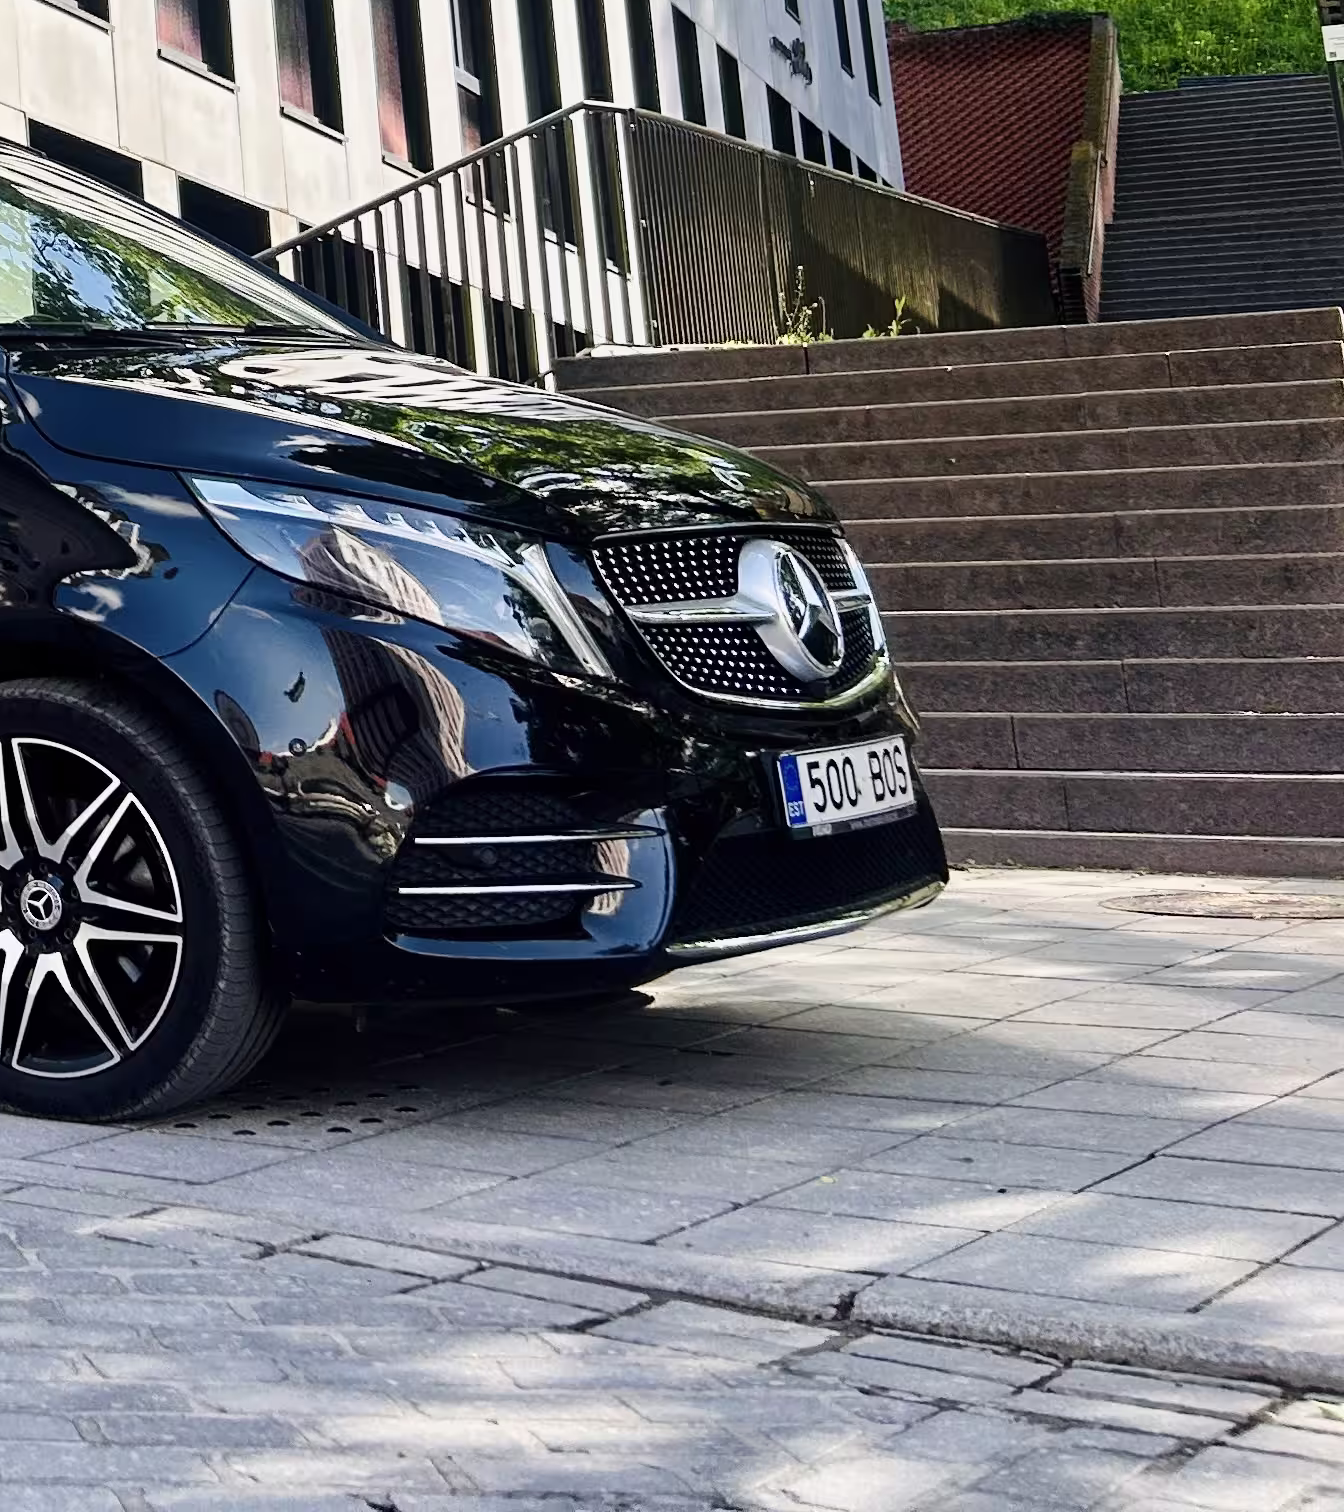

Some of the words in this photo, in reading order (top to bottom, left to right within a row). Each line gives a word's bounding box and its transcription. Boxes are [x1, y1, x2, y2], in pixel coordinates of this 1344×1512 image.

[806, 756, 858, 813] 500
[867, 745, 907, 802] BOS
[788, 801, 804, 817] EST
